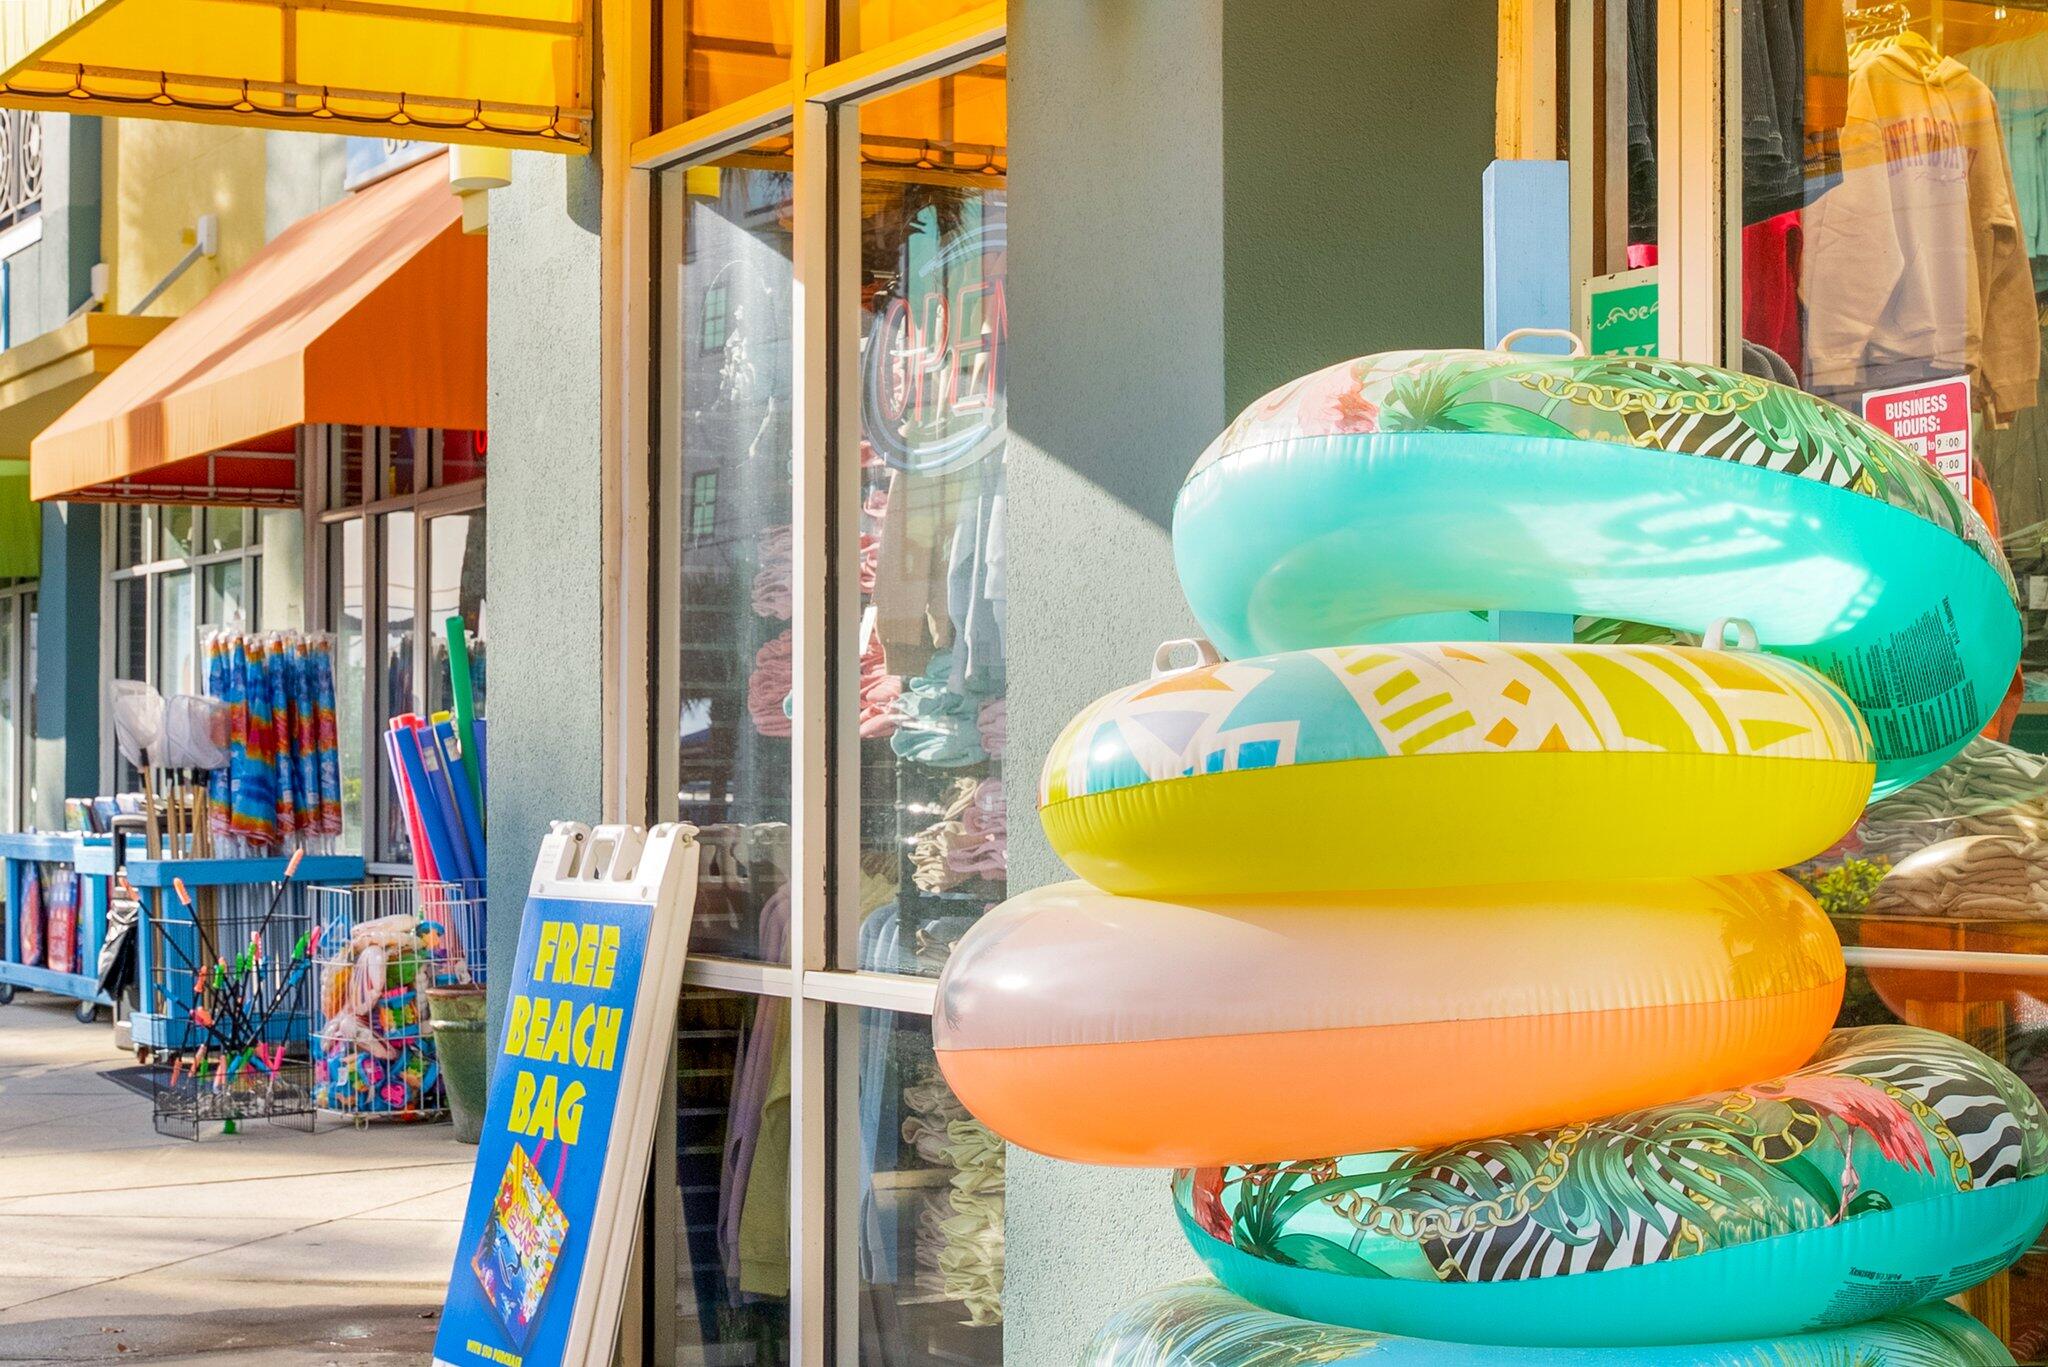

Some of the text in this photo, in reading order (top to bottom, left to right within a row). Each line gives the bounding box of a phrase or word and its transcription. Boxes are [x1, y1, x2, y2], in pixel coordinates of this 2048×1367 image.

[1885, 393, 1948, 421] BUSINESS
[1894, 415, 1941, 438] HOURS:
[533, 921, 621, 989] FREE
[504, 995, 624, 1072] BEACH
[507, 1070, 586, 1146] BAG
